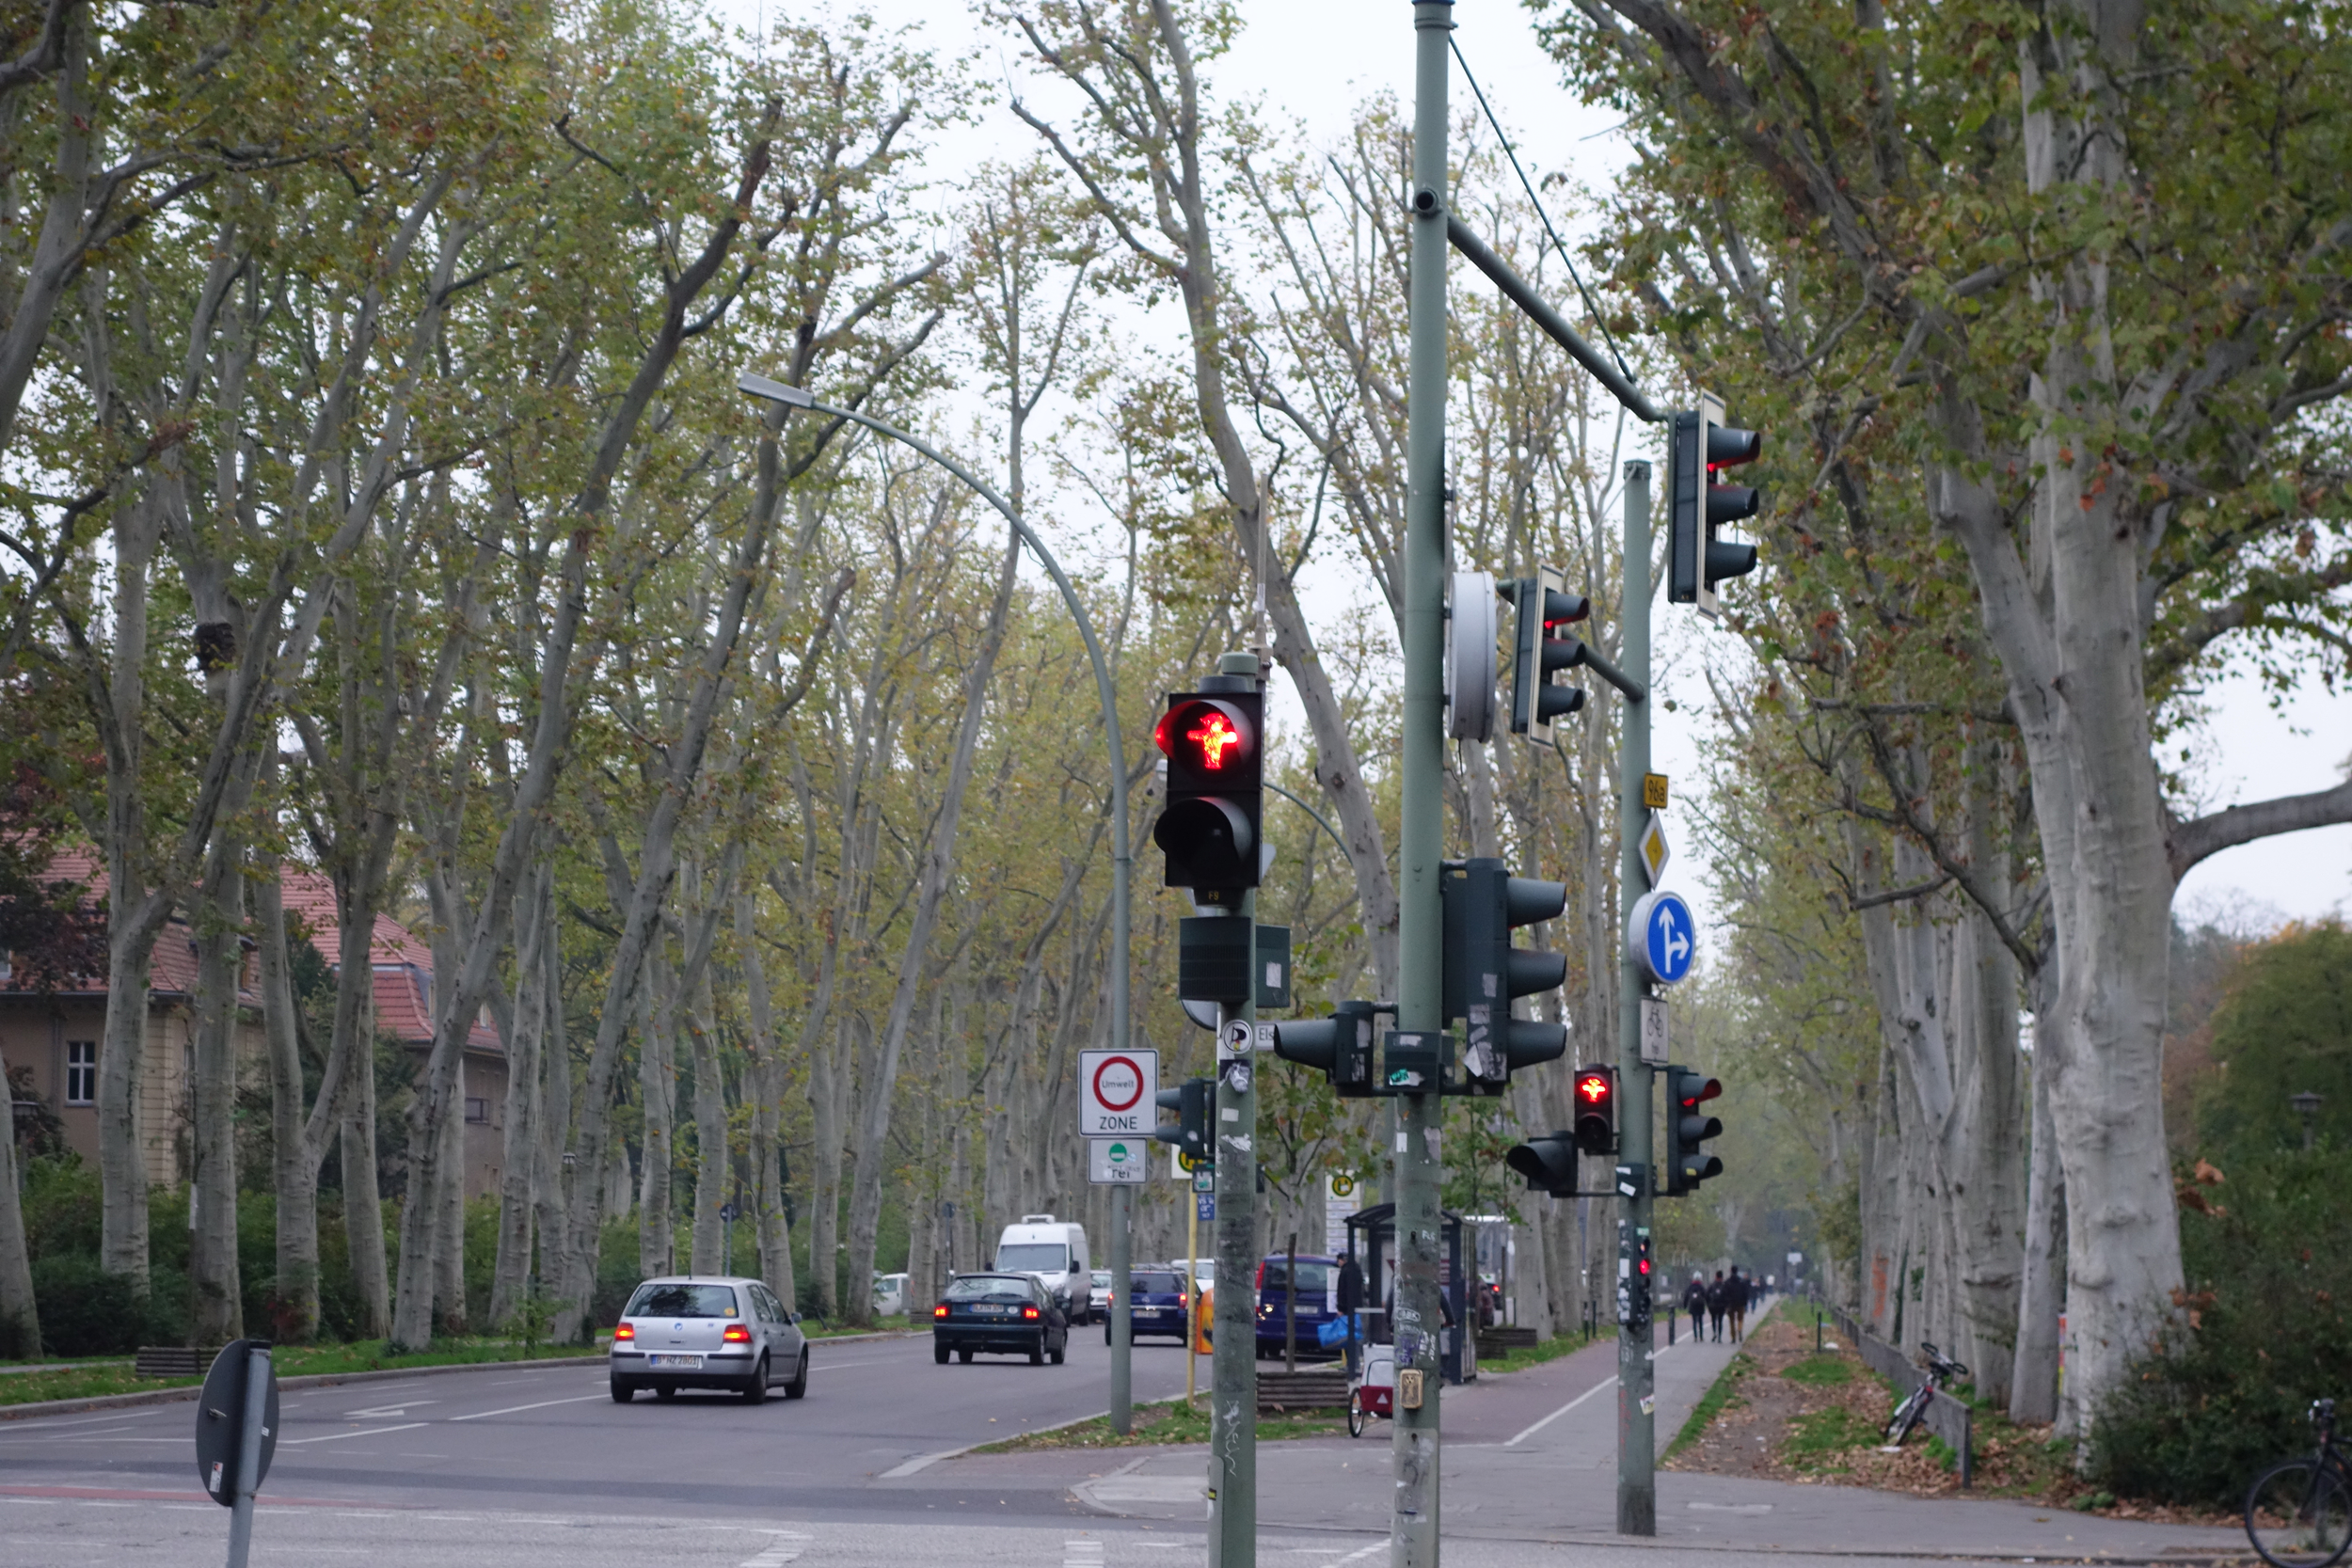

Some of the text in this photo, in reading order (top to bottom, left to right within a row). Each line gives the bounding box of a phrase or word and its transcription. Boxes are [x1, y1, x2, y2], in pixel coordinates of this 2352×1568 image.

[1648, 779, 1665, 802] 96a
[1101, 1080, 1135, 1089] Umwelt
[1099, 1116, 1138, 1130] ZONE
[1108, 1167, 1131, 1179] rei
